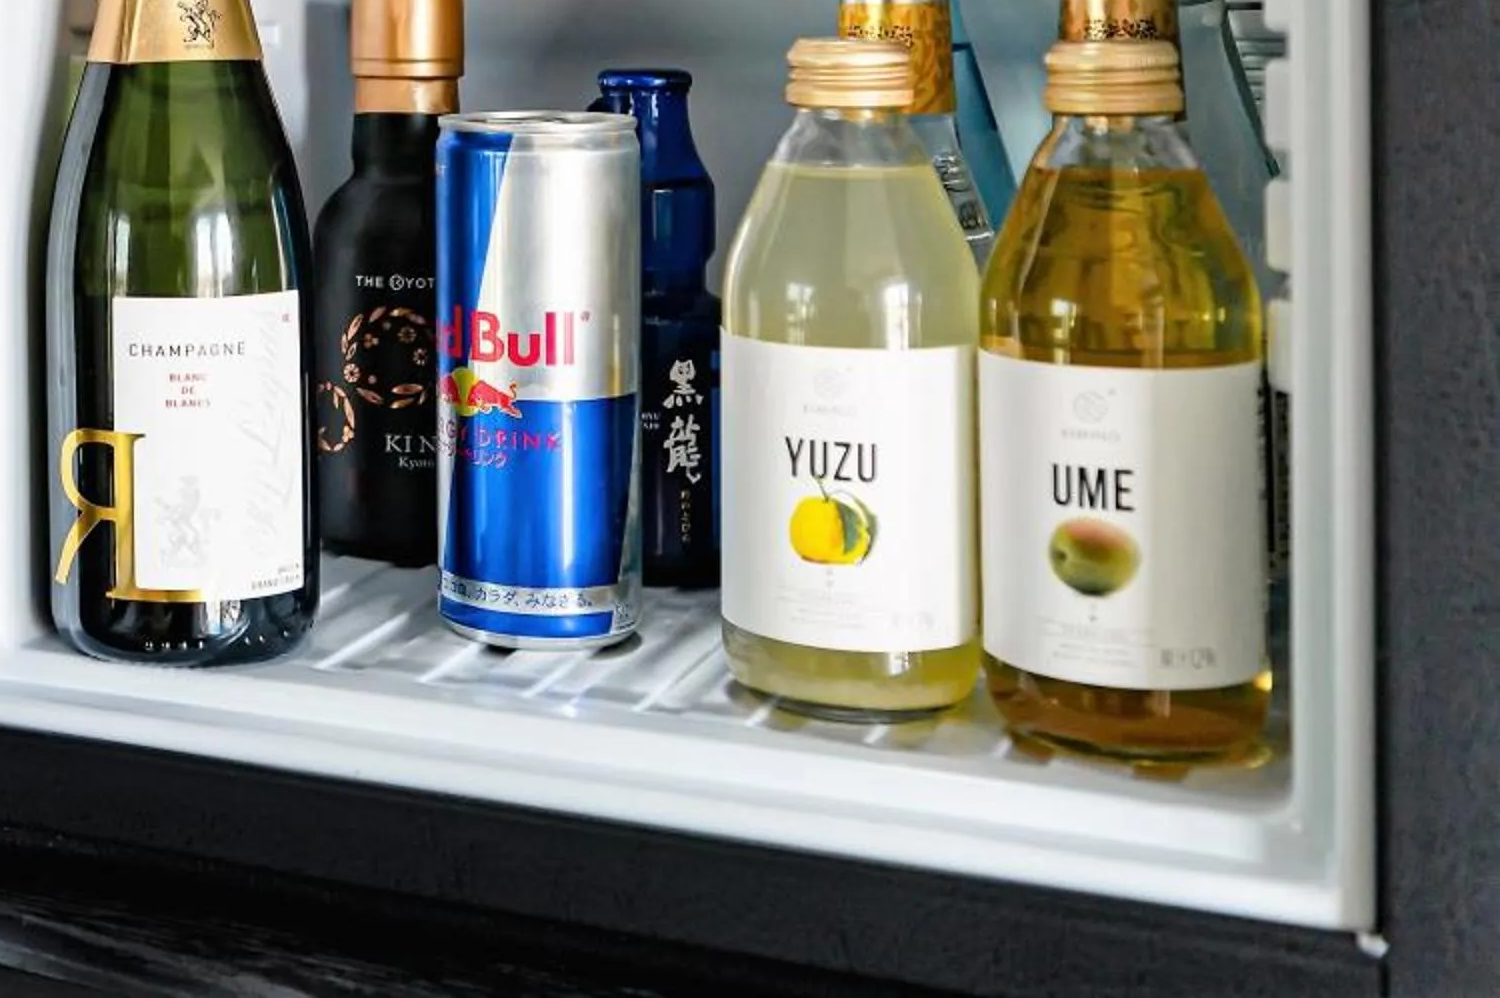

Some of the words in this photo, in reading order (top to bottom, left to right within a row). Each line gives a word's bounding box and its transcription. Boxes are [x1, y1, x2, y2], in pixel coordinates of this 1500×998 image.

[355, 274, 384, 289] THE
[388, 273, 436, 291] KYOT
[129, 341, 245, 358] CHAMPAGNE
[785, 436, 878, 483] YUZU
[1052, 463, 1135, 513] UME
